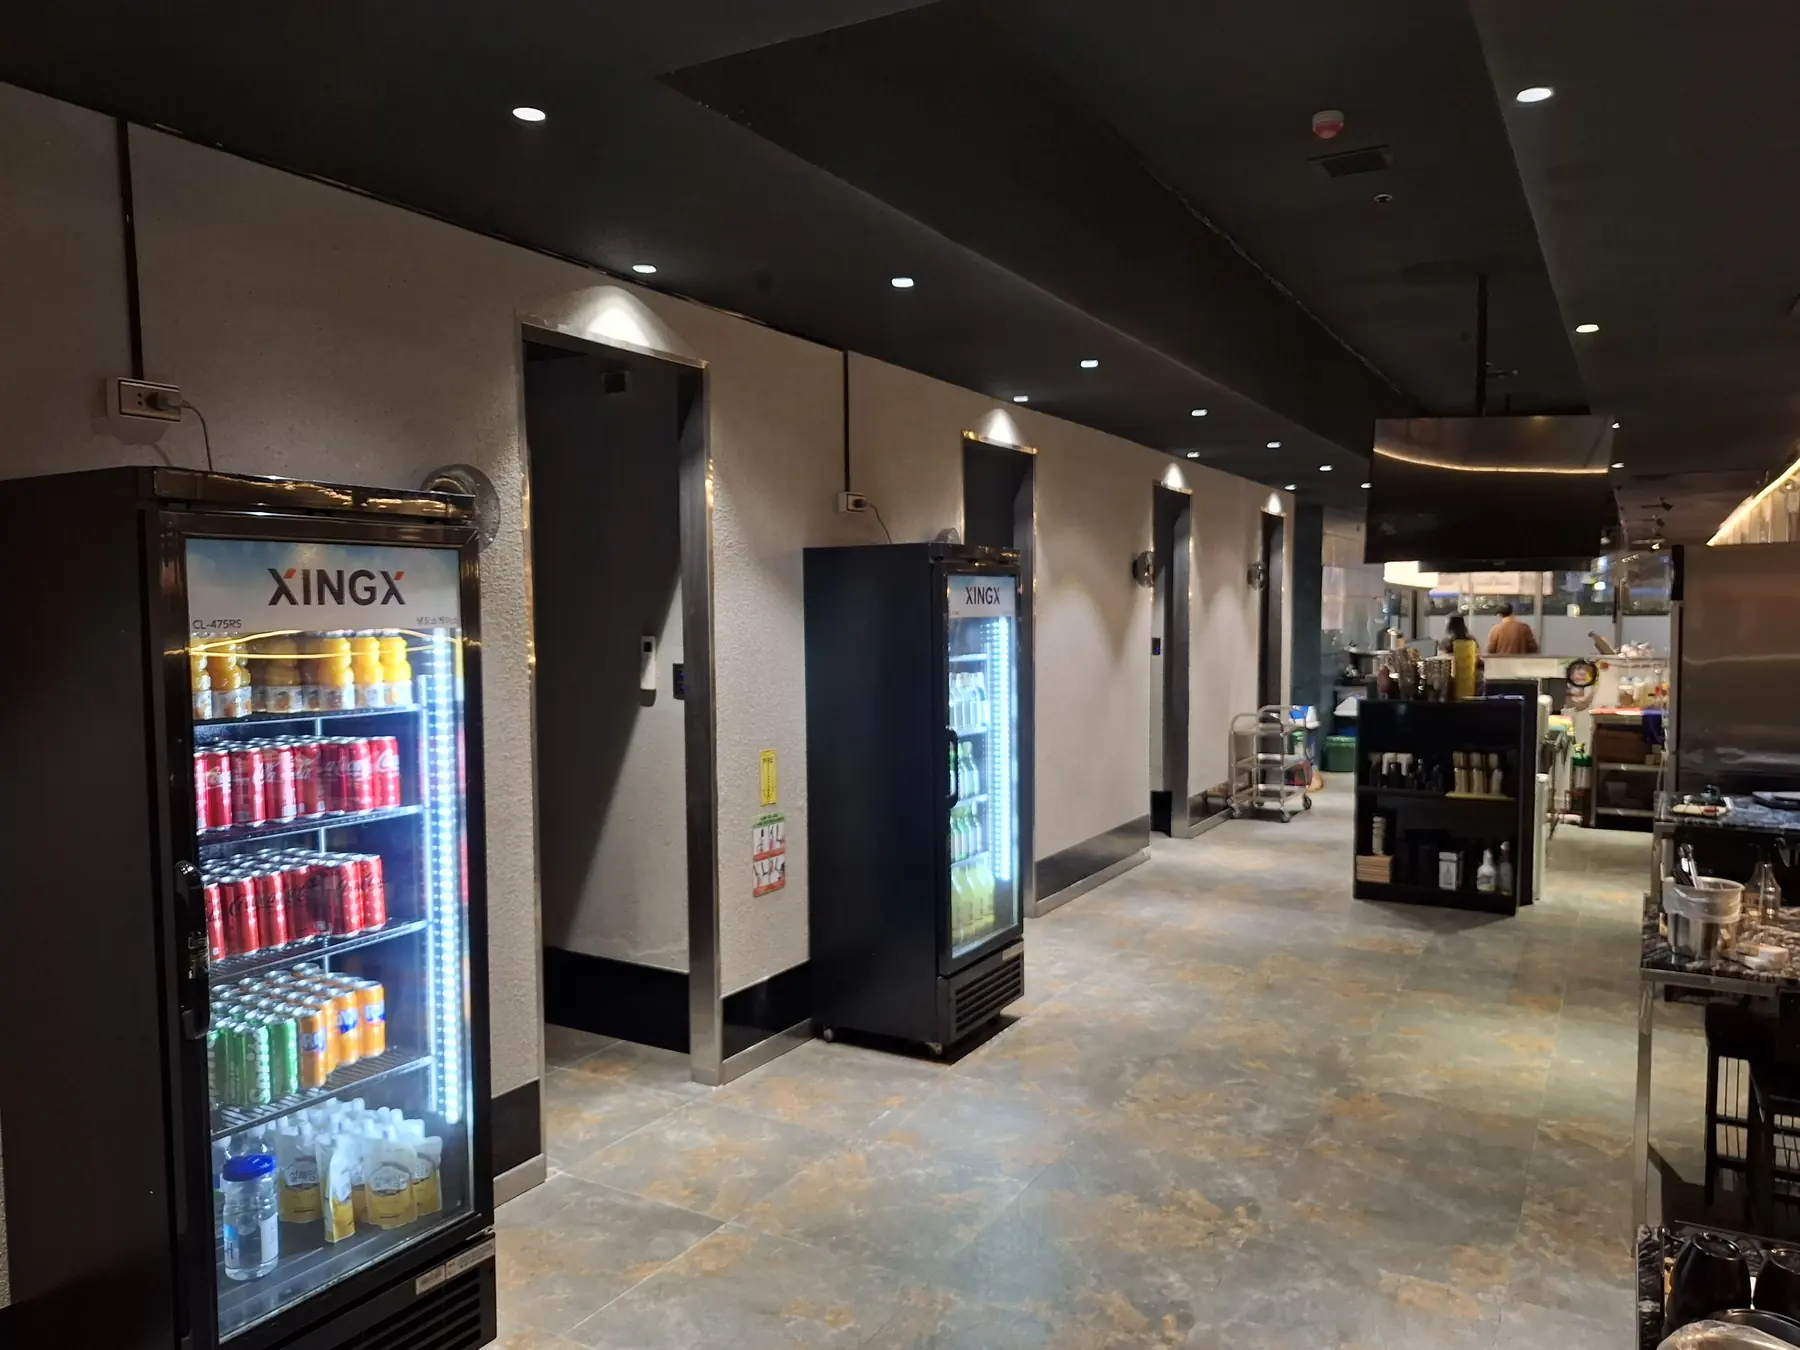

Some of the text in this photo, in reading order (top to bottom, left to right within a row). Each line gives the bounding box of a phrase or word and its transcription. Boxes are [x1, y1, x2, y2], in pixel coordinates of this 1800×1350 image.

[267, 568, 406, 606] XINGX
[965, 586, 1001, 605] XINGX
[192, 619, 242, 630] CL-475RS
